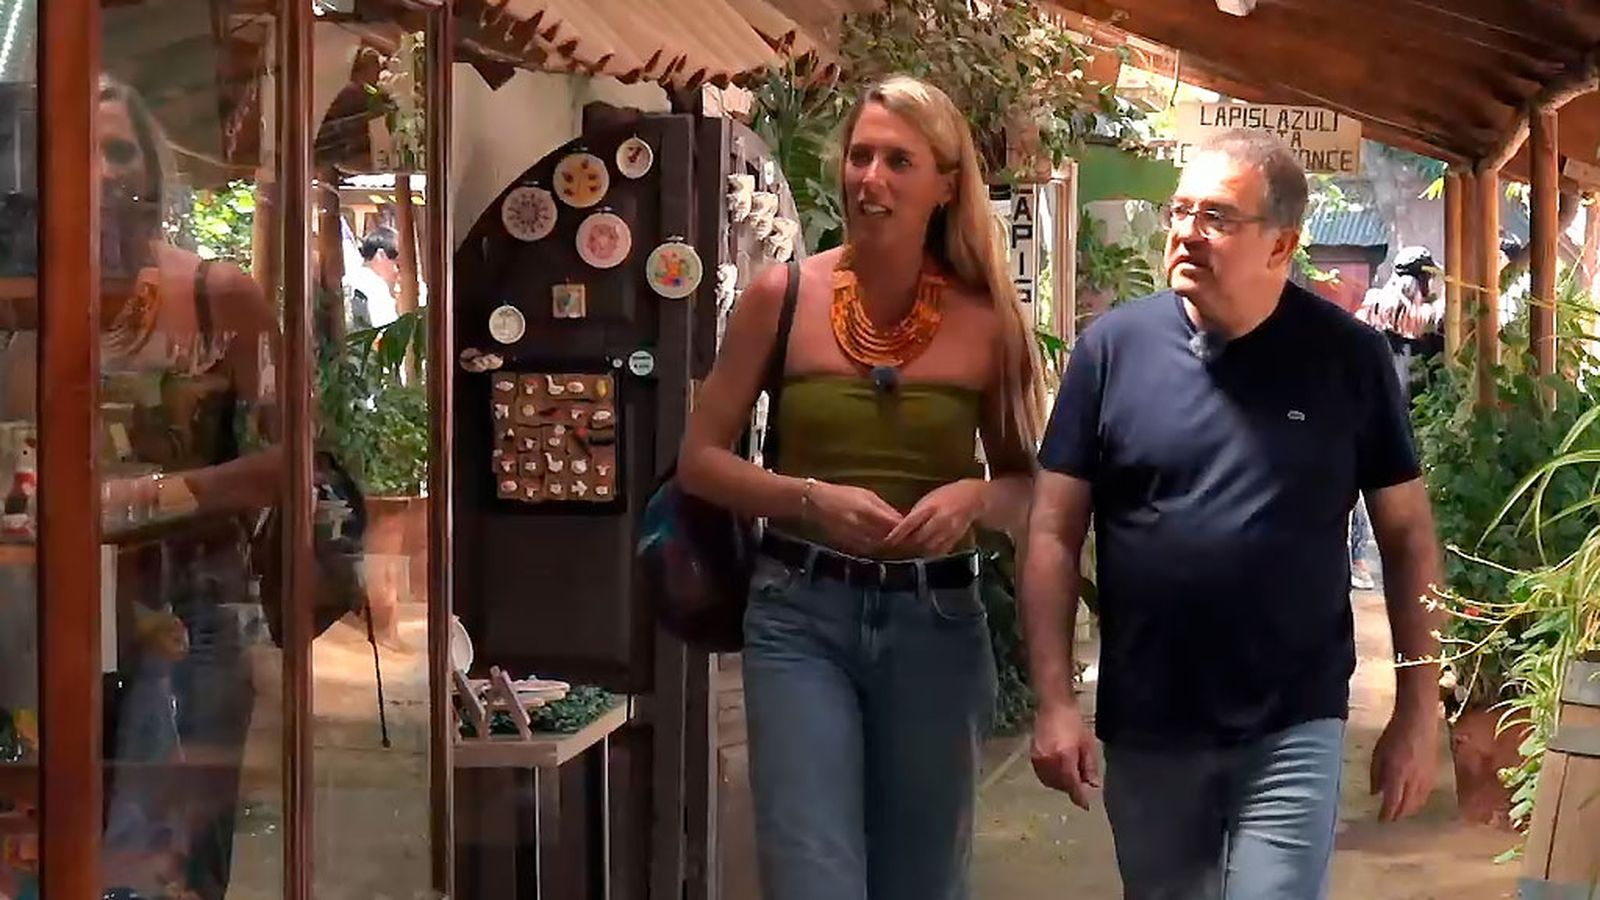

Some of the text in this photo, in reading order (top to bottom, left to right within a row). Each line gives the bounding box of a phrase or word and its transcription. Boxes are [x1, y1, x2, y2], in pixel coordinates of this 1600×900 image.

[1200, 106, 1339, 132] LAPISLAZULI
[1291, 148, 1353, 172] ONCE
[1011, 188, 1033, 303] APIS
